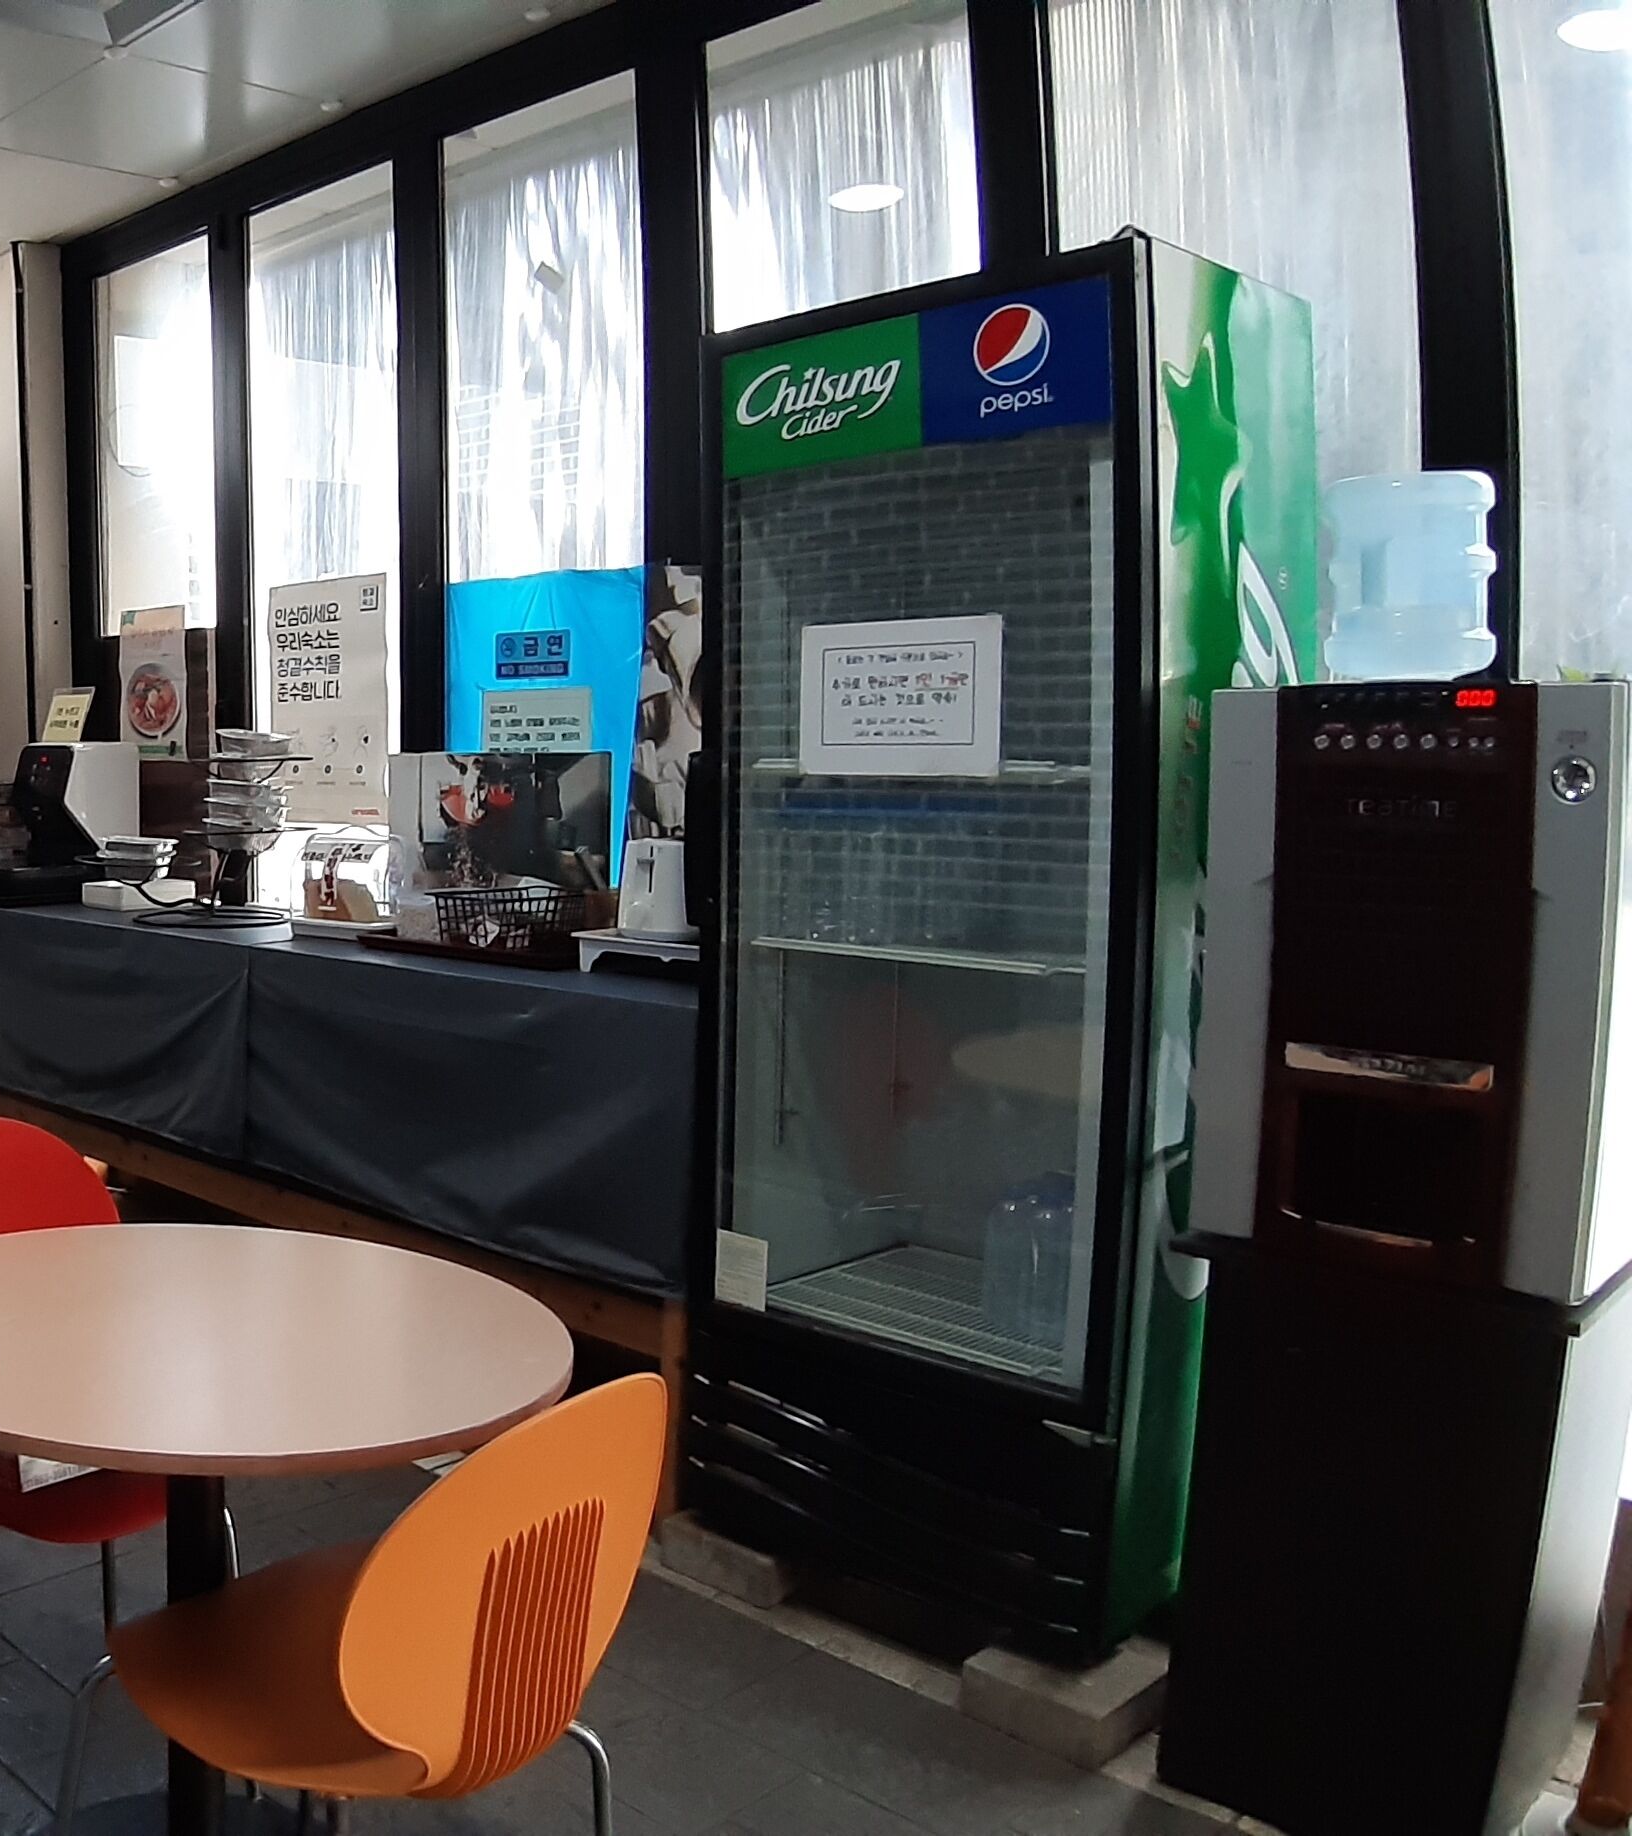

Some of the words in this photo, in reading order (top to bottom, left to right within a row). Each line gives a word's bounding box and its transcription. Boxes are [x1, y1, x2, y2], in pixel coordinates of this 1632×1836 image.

[736, 359, 901, 426] Chilsung
[979, 383, 1050, 418] pepsi
[781, 404, 858, 441] Cider
[276, 629, 340, 652] 우리숙소는
[276, 653, 341, 678] 청결수칙을
